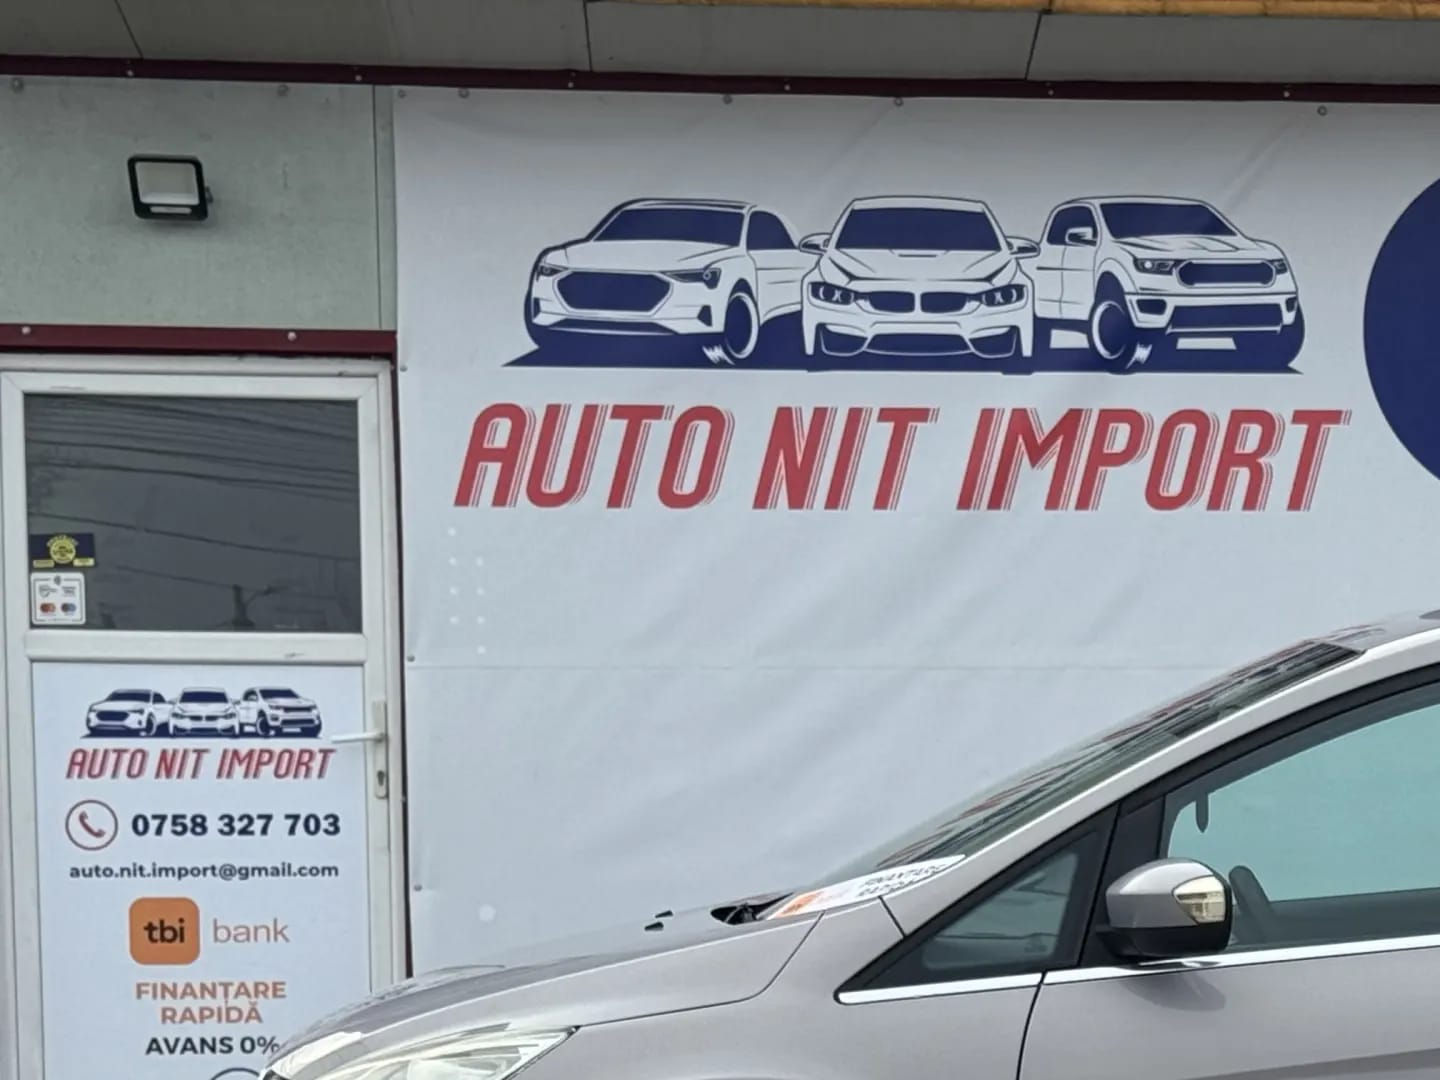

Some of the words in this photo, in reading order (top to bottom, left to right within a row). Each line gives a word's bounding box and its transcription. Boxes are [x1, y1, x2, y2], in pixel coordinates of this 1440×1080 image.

[453, 402, 734, 509] AUTO
[753, 405, 939, 511] NIT
[957, 407, 1351, 512] IMPORT
[65, 748, 149, 780] AUTO
[154, 748, 211, 780] NIT
[215, 748, 337, 780] IMPORT
[131, 813, 209, 837] 0758
[217, 813, 274, 837] 327
[284, 813, 341, 837] 703
[69, 861, 339, 881] auto.nit.import@gmail.com
[143, 917, 185, 944] tbi
[212, 917, 290, 944] bank
[144, 1036, 234, 1056] AVANS
[239, 1035, 281, 1055] 0%
